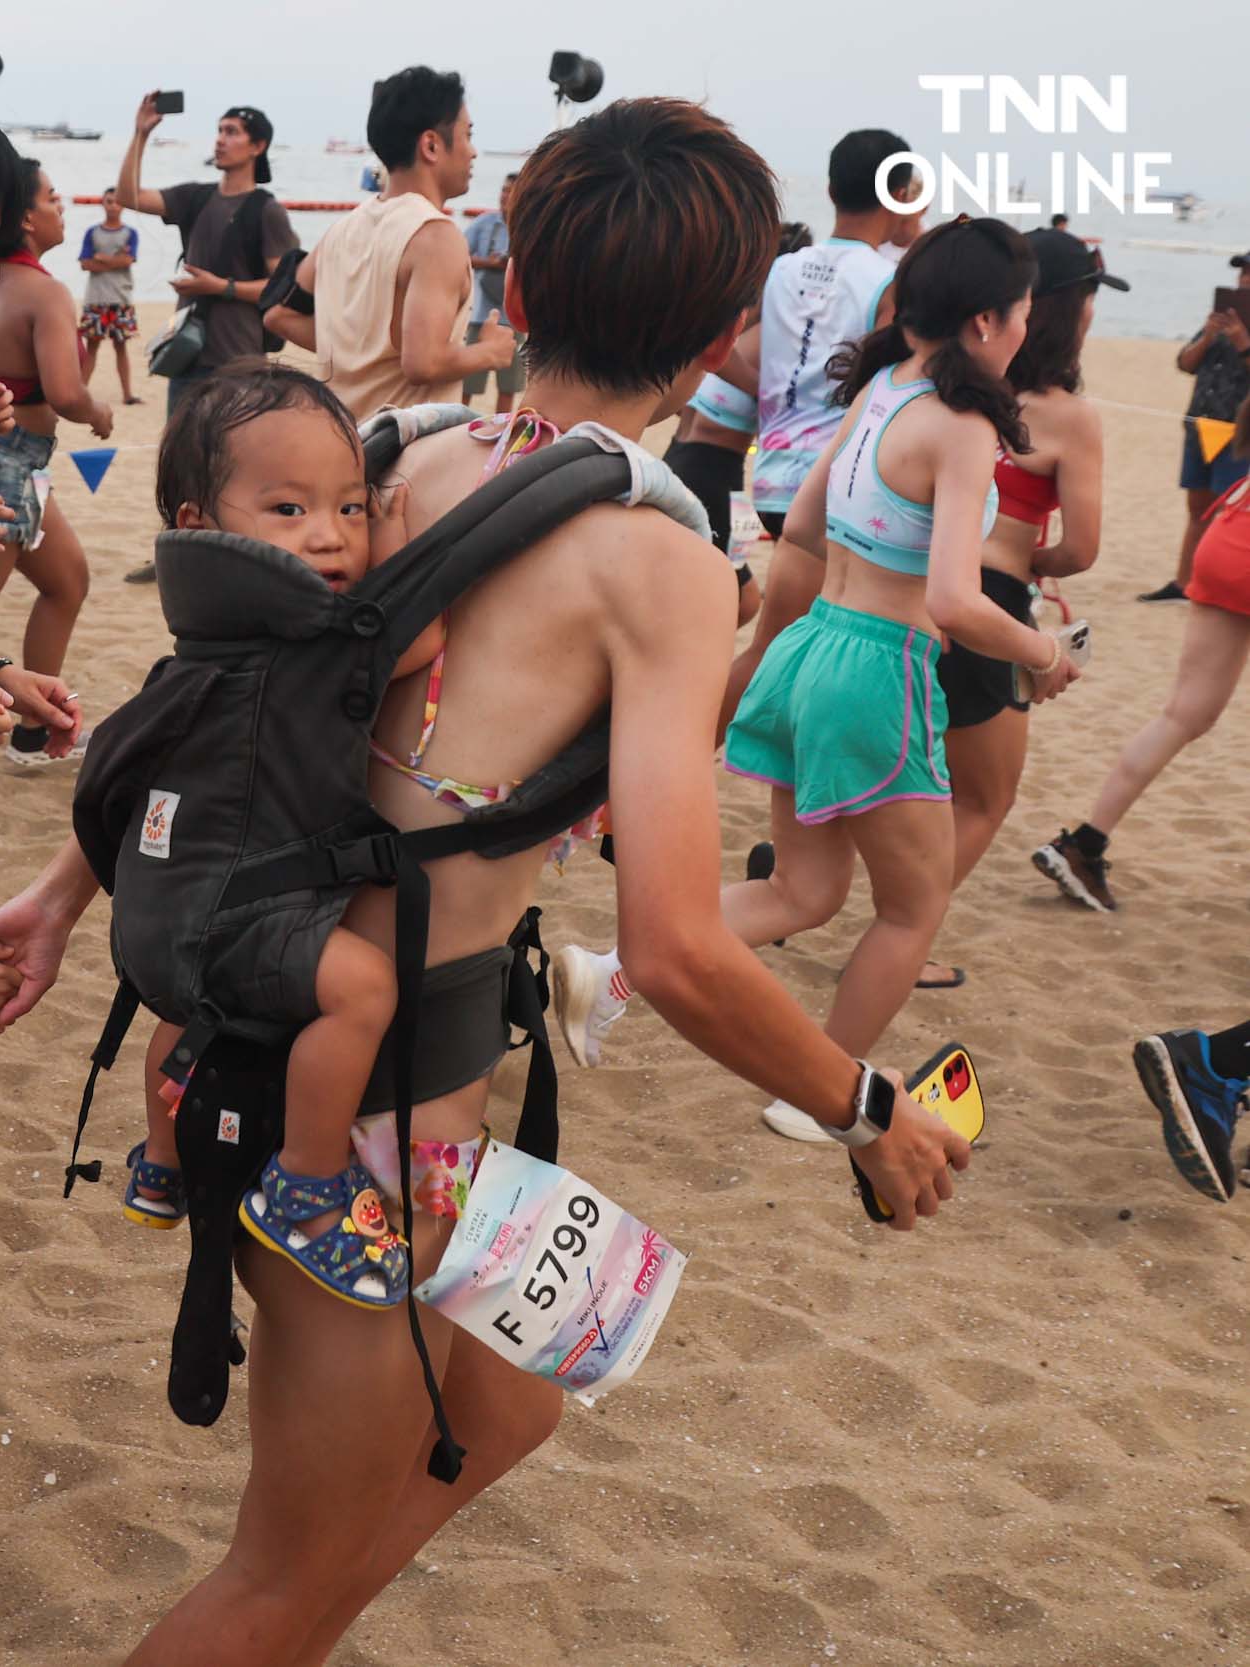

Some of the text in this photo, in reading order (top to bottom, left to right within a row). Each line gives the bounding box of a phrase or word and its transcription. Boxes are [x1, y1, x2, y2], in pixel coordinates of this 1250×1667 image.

[492, 1195, 600, 1346] F 5799
[638, 1257, 661, 1293] 5KM
[576, 1305, 593, 1327] MIKI
